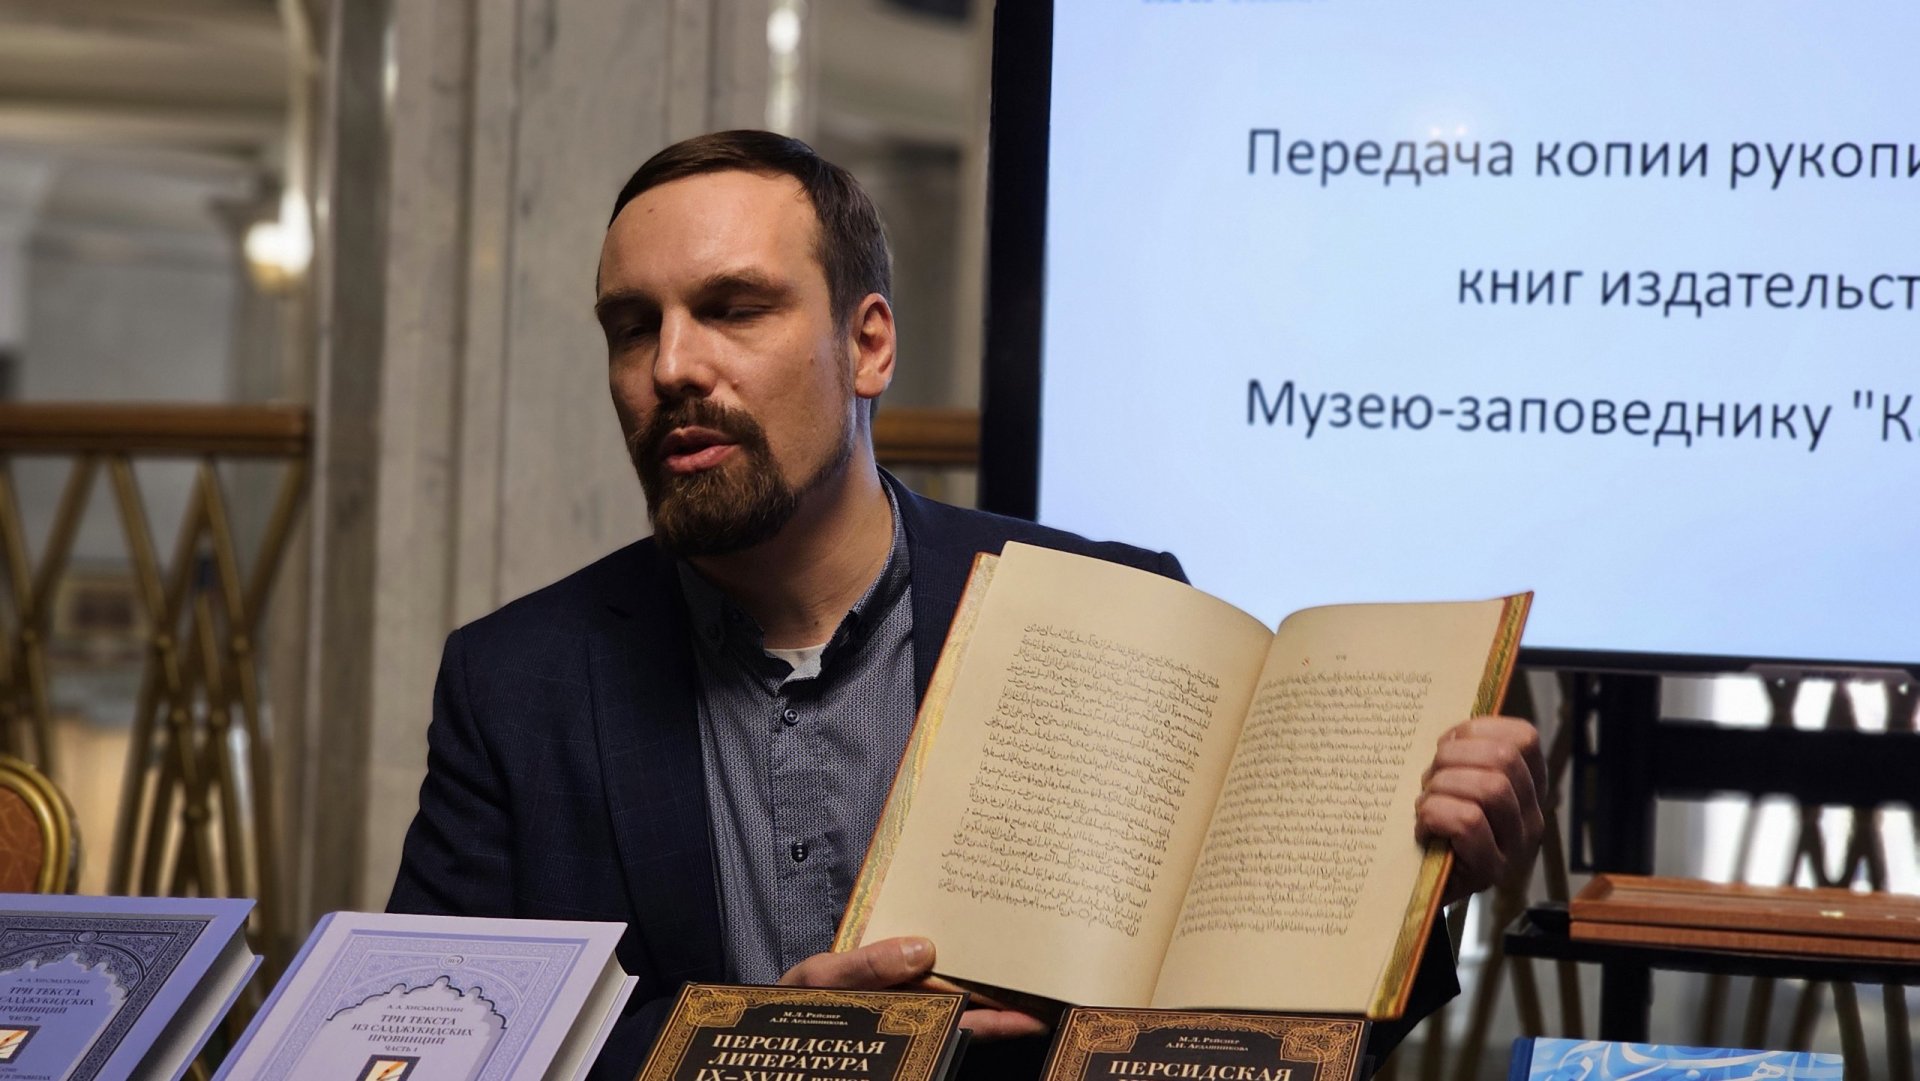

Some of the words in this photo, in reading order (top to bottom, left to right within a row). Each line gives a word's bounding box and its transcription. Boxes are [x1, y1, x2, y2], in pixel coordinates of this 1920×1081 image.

[1248, 128, 1513, 187] Передача
[1535, 140, 1709, 178] копии
[1458, 269, 1584, 306] книг
[1601, 270, 1920, 318] издательст
[1247, 378, 1833, 453] Музею-заповеднику
[1853, 389, 1920, 442] "К
[10, 986, 34, 995] ТРИ
[36, 988, 81, 997] ТЕКСТА
[351, 1023, 369, 1031] ИЗ
[370, 1024, 474, 1037] САЛДЖУКИДСКИХ
[380, 1014, 406, 1023] ТРИ
[409, 1016, 456, 1025] ТЕКСТА
[367, 1034, 446, 1045] ПРОВИНЦИЙ
[712, 1034, 887, 1055] ПЕРСИДСКАЯ
[708, 1051, 869, 1072] ЛИТЕРАТУРА
[1109, 1060, 1294, 1081] ПЕРСИДСКАЯ
